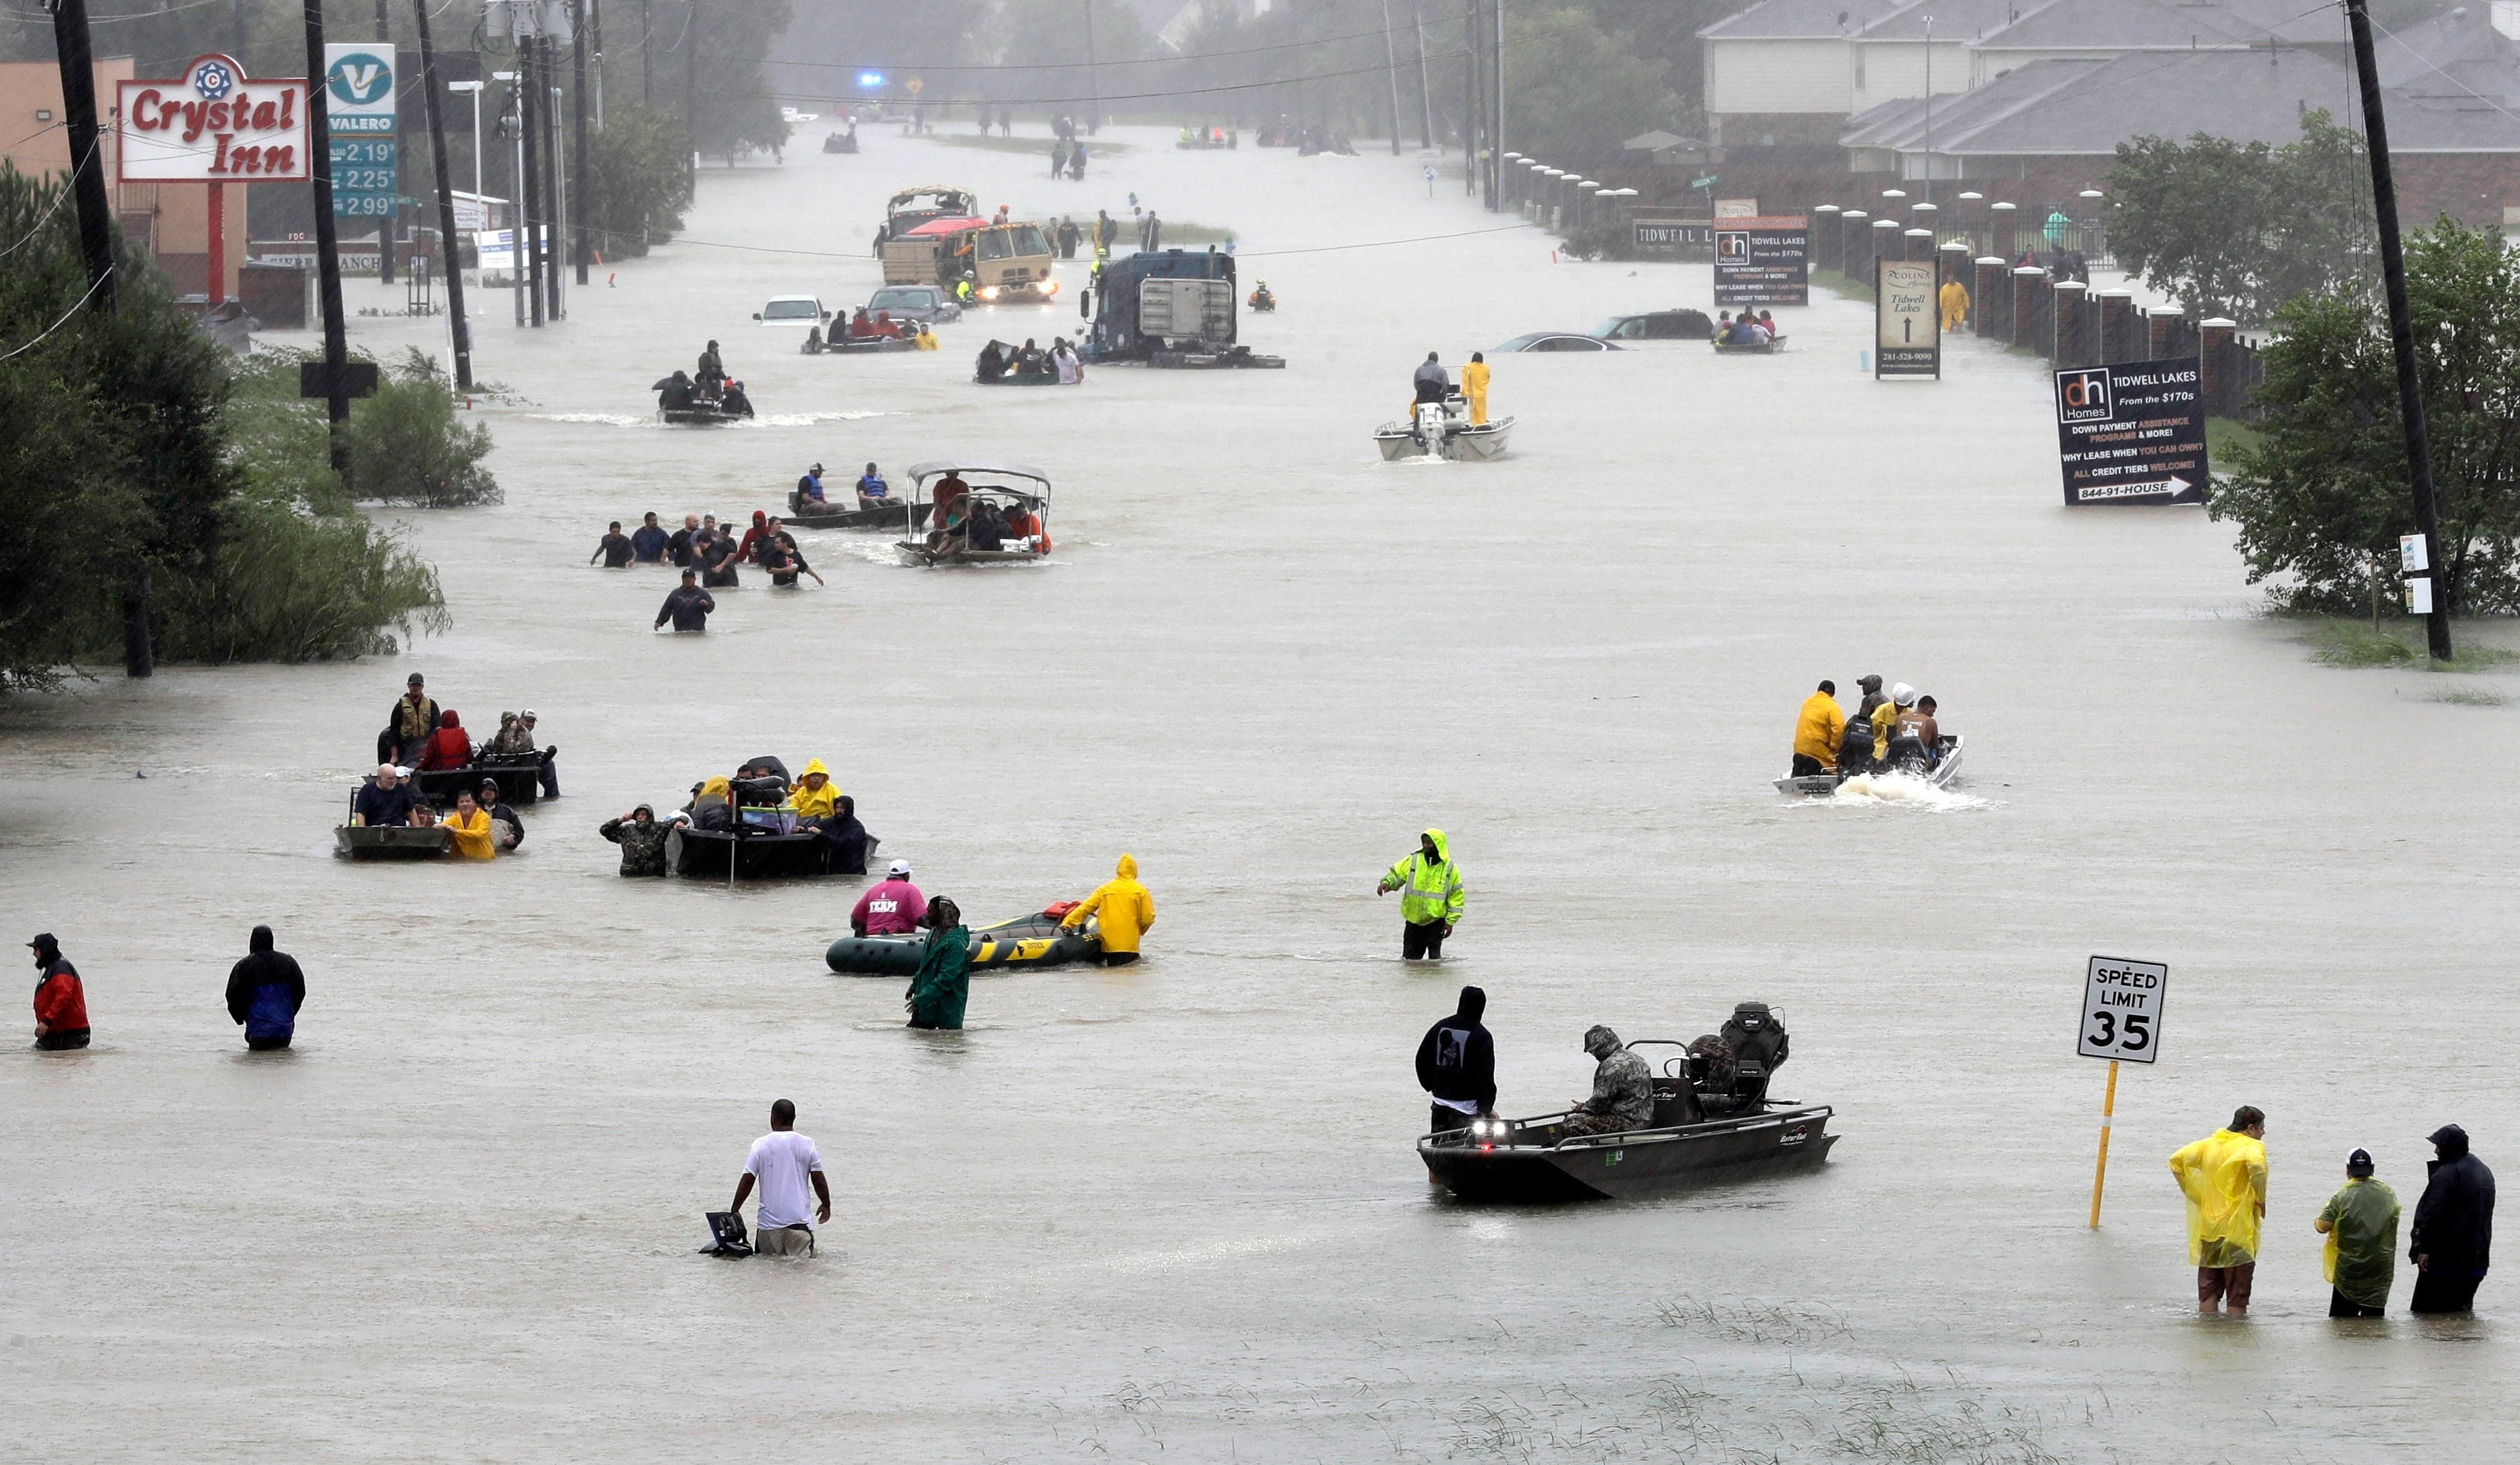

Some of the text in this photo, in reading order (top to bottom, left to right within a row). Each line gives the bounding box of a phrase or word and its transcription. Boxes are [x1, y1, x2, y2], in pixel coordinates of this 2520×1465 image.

[209, 75, 217, 85] C
[341, 64, 378, 99] V
[132, 88, 295, 143] Crystal
[329, 118, 391, 130] VALERO
[208, 133, 295, 173] Inn
[289, 232, 304, 241] FDC
[1720, 234, 1744, 255] dh
[341, 257, 381, 269] ANCH
[1892, 294, 1926, 304] Tidwell
[1895, 304, 1921, 313] Lakes
[2066, 371, 2196, 407] dh TIDWELL LAKES
[2119, 392, 2194, 406] From the $170s
[2067, 408, 2105, 420] Homes
[2072, 417, 2190, 435] DOWN PAYMENT ASSISTANCE
[2090, 431, 2136, 444] PROGRAMS
[2146, 429, 2173, 438] MORE!
[2062, 442, 2203, 462] WHY LEASE WHEN YOU CAN OWN?
[2074, 460, 2196, 479] ALL CREDIT TIERS WELCOME!
[2081, 483, 2169, 499] 844-91-HOUSE
[2095, 968, 2158, 989] SPEED
[2101, 990, 2147, 1009] LIMIT
[2087, 1011, 2150, 1051] 35
